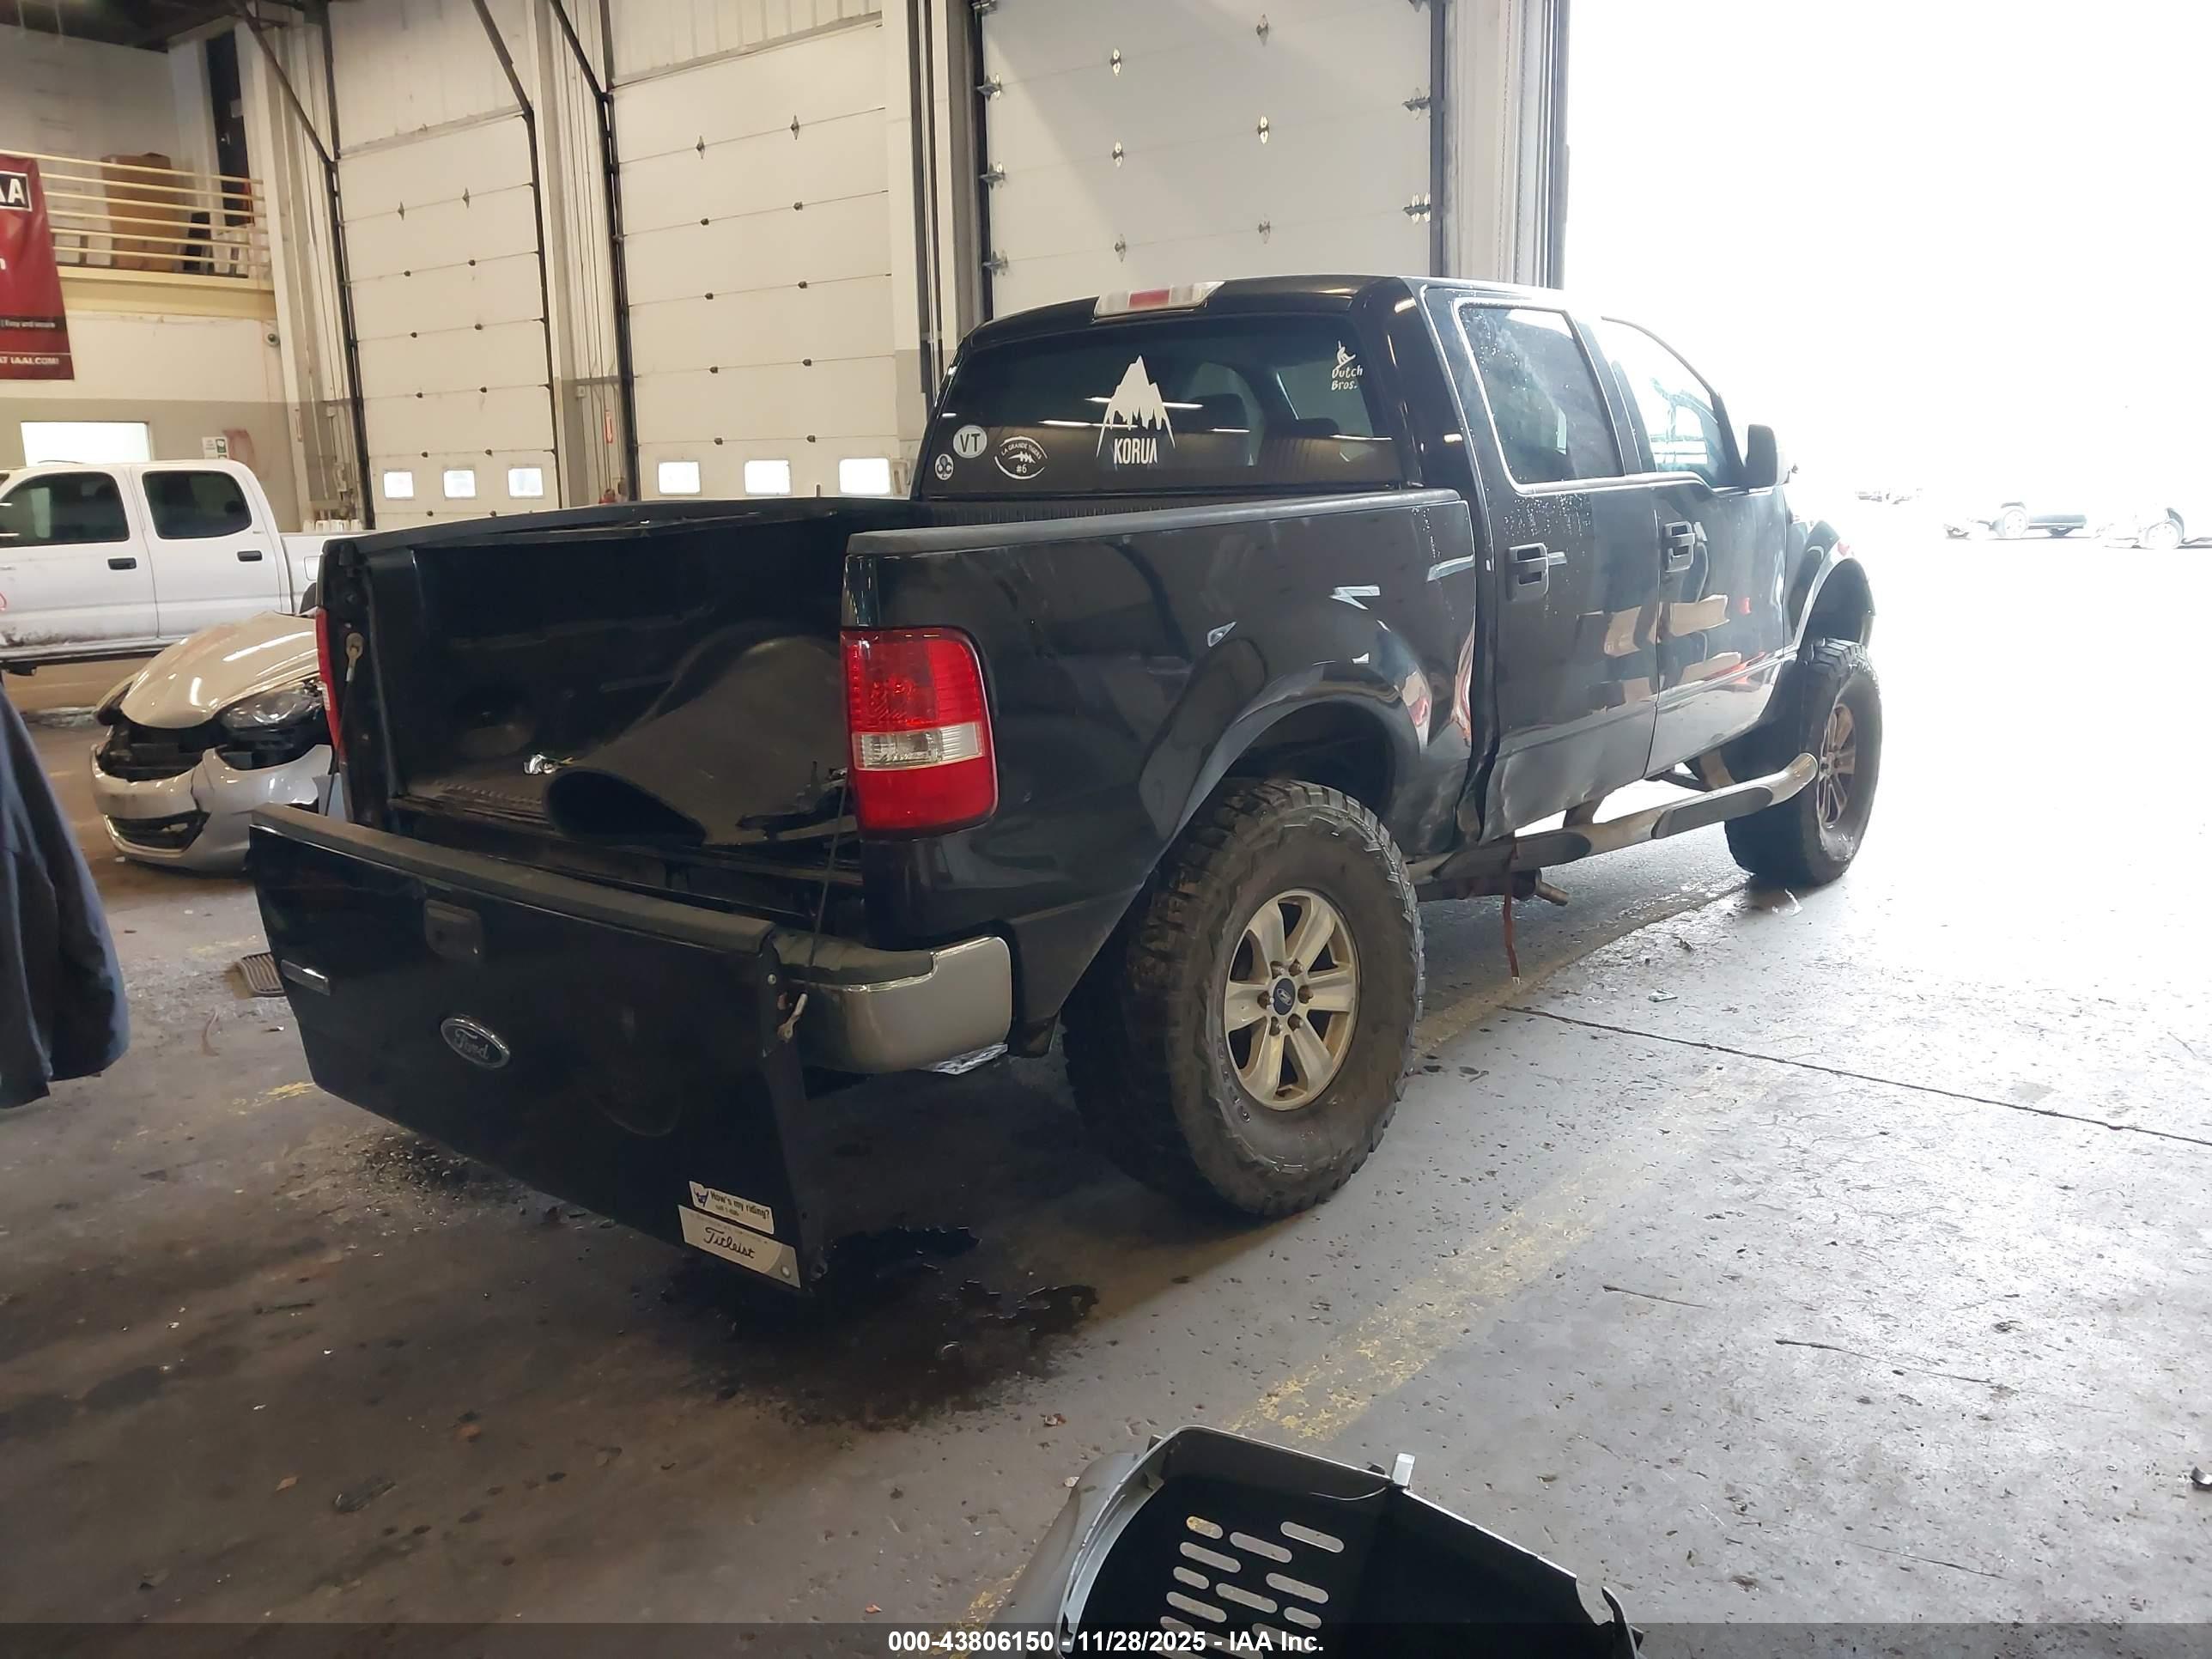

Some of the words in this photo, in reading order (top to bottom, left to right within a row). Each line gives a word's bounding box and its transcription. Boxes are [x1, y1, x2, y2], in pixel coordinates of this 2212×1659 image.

[1331, 364, 1364, 379] Dutch
[1331, 380, 1358, 391] Bros.
[959, 433, 981, 453] VT
[1000, 447, 1008, 456] LA
[1007, 442, 1028, 451] GRANDE
[1113, 437, 1158, 465] KORUA
[1016, 464, 1028, 474] #6
[454, 1028, 489, 1060] Ford
[709, 1190, 732, 1206] How's
[733, 1200, 744, 1212] my
[745, 1204, 770, 1220] riding?
[703, 1226, 756, 1259] Titleist
